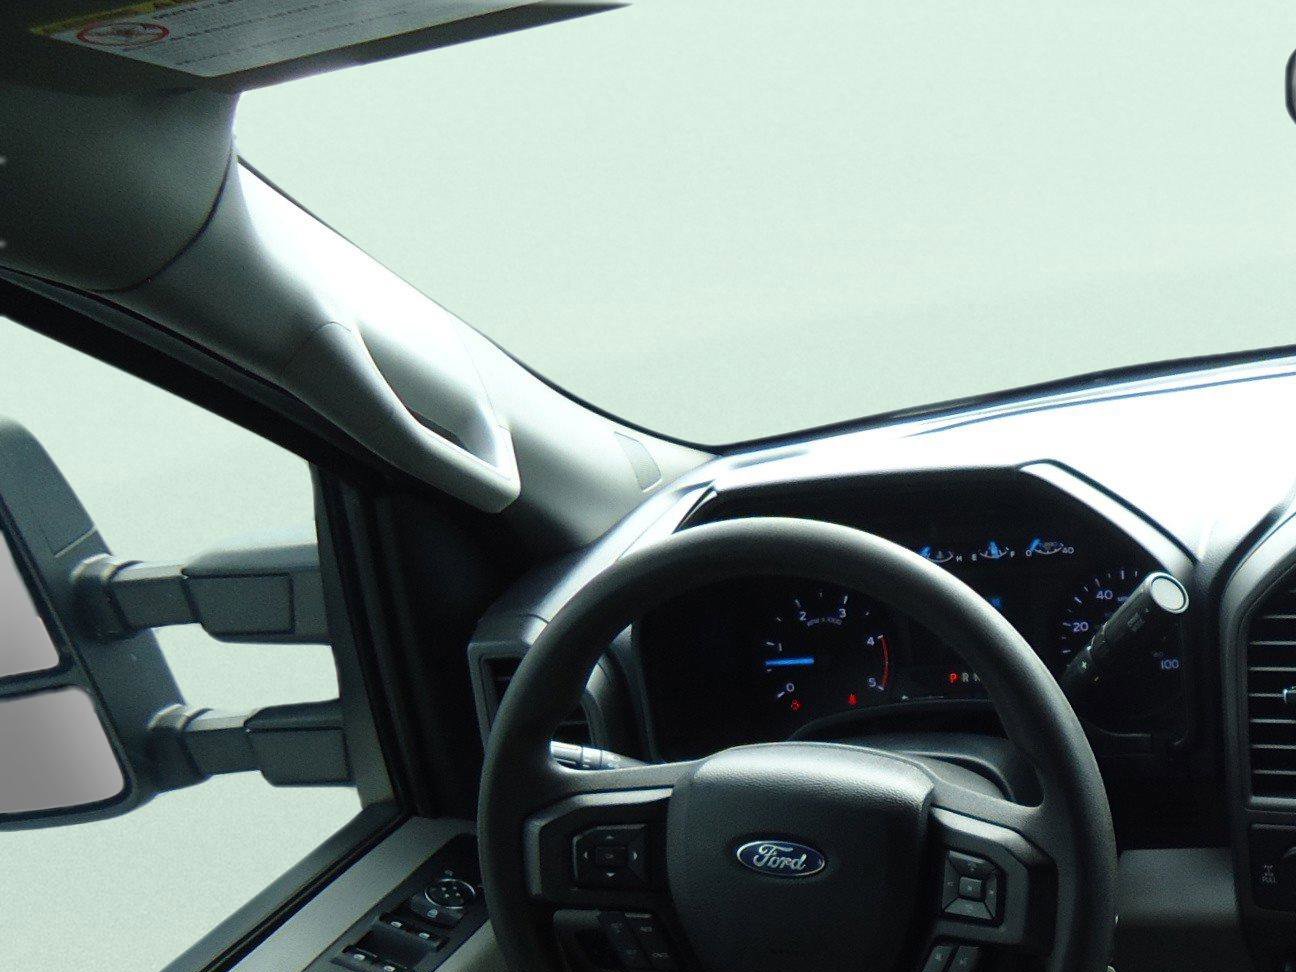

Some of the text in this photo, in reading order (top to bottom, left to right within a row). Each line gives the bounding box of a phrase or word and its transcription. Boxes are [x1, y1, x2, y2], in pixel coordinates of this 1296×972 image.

[1095, 588, 1114, 600] 40
[799, 611, 808, 622] 2
[838, 607, 848, 619] 3
[1072, 620, 1089, 633] 20
[866, 635, 876, 647] 4
[1160, 658, 1180, 671] 100
[949, 672, 958, 683] P
[962, 671, 970, 683] R
[785, 682, 796, 693] 0
[752, 843, 808, 871] Ford
